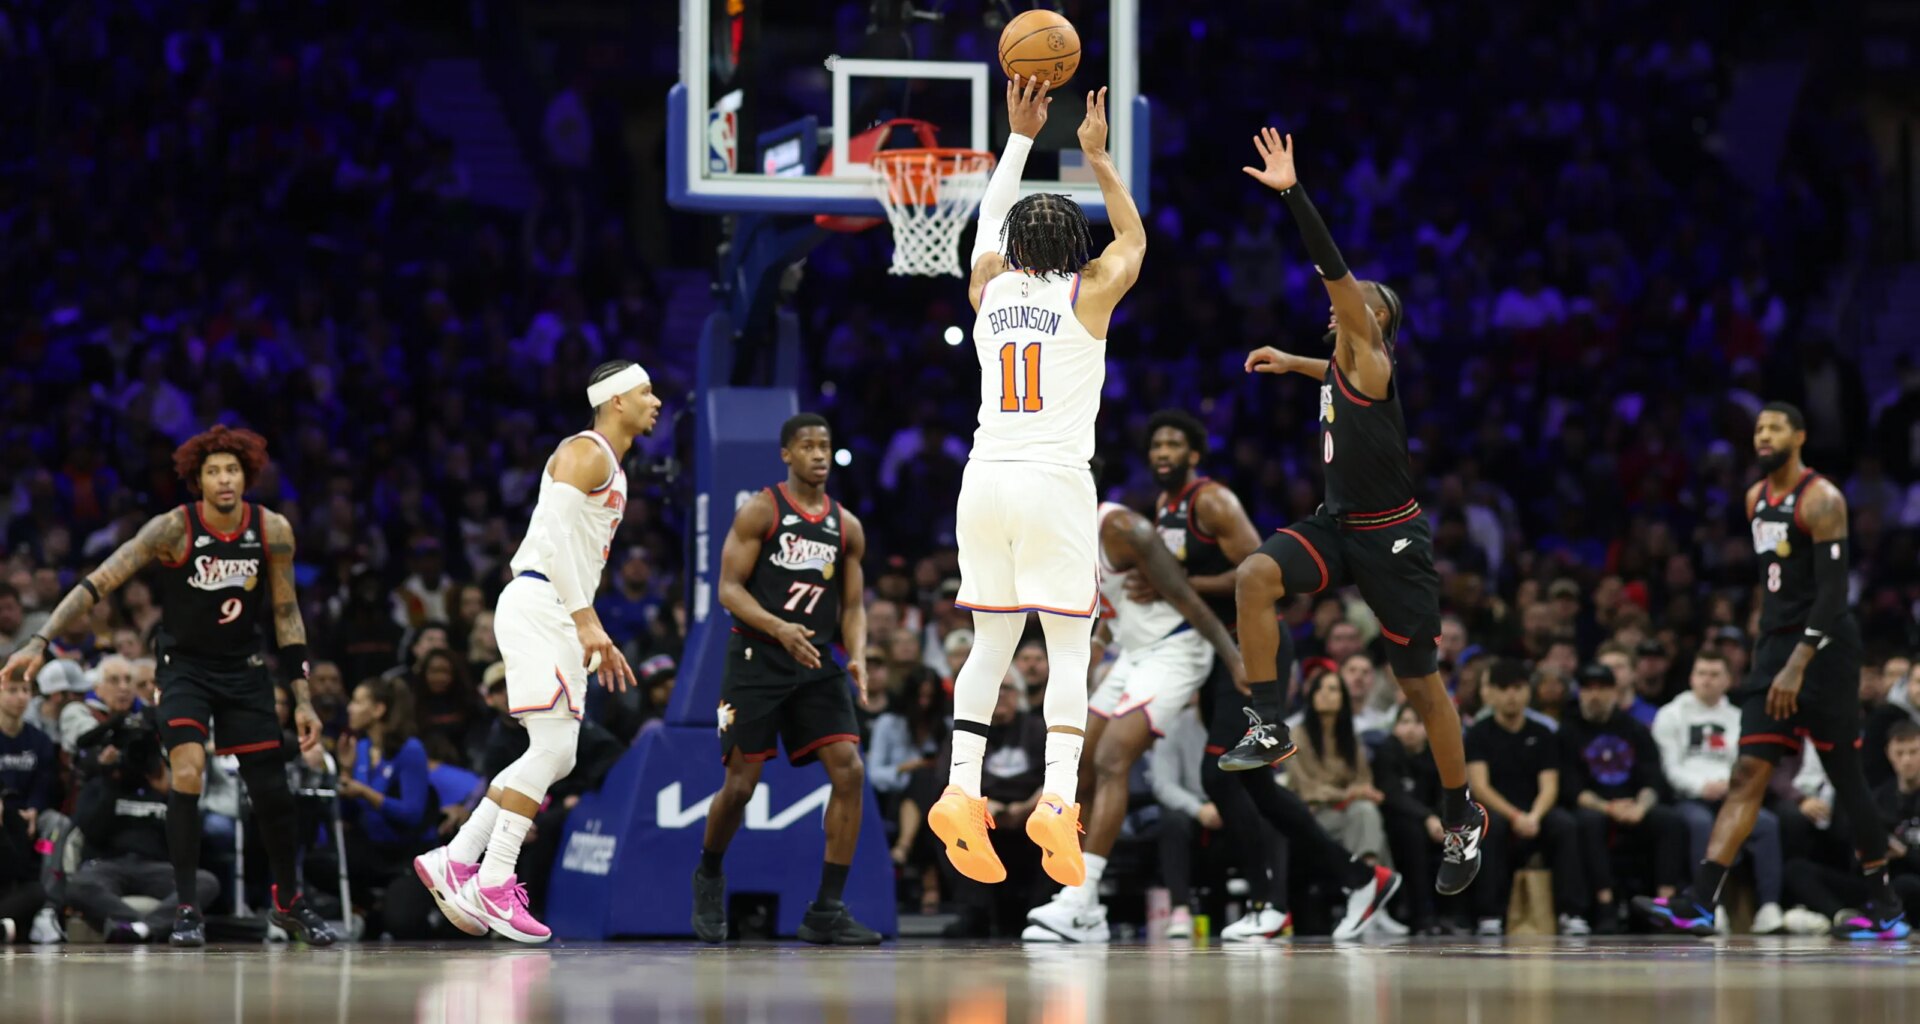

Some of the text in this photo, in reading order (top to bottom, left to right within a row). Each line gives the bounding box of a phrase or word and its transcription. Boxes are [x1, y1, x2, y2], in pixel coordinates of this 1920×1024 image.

[988, 305, 1061, 336] BRUNSON
[999, 341, 1043, 413] 11
[769, 532, 838, 571] SIXERS
[187, 555, 259, 591] SIXERS
[218, 597, 243, 624] 9
[783, 581, 825, 615] 77
